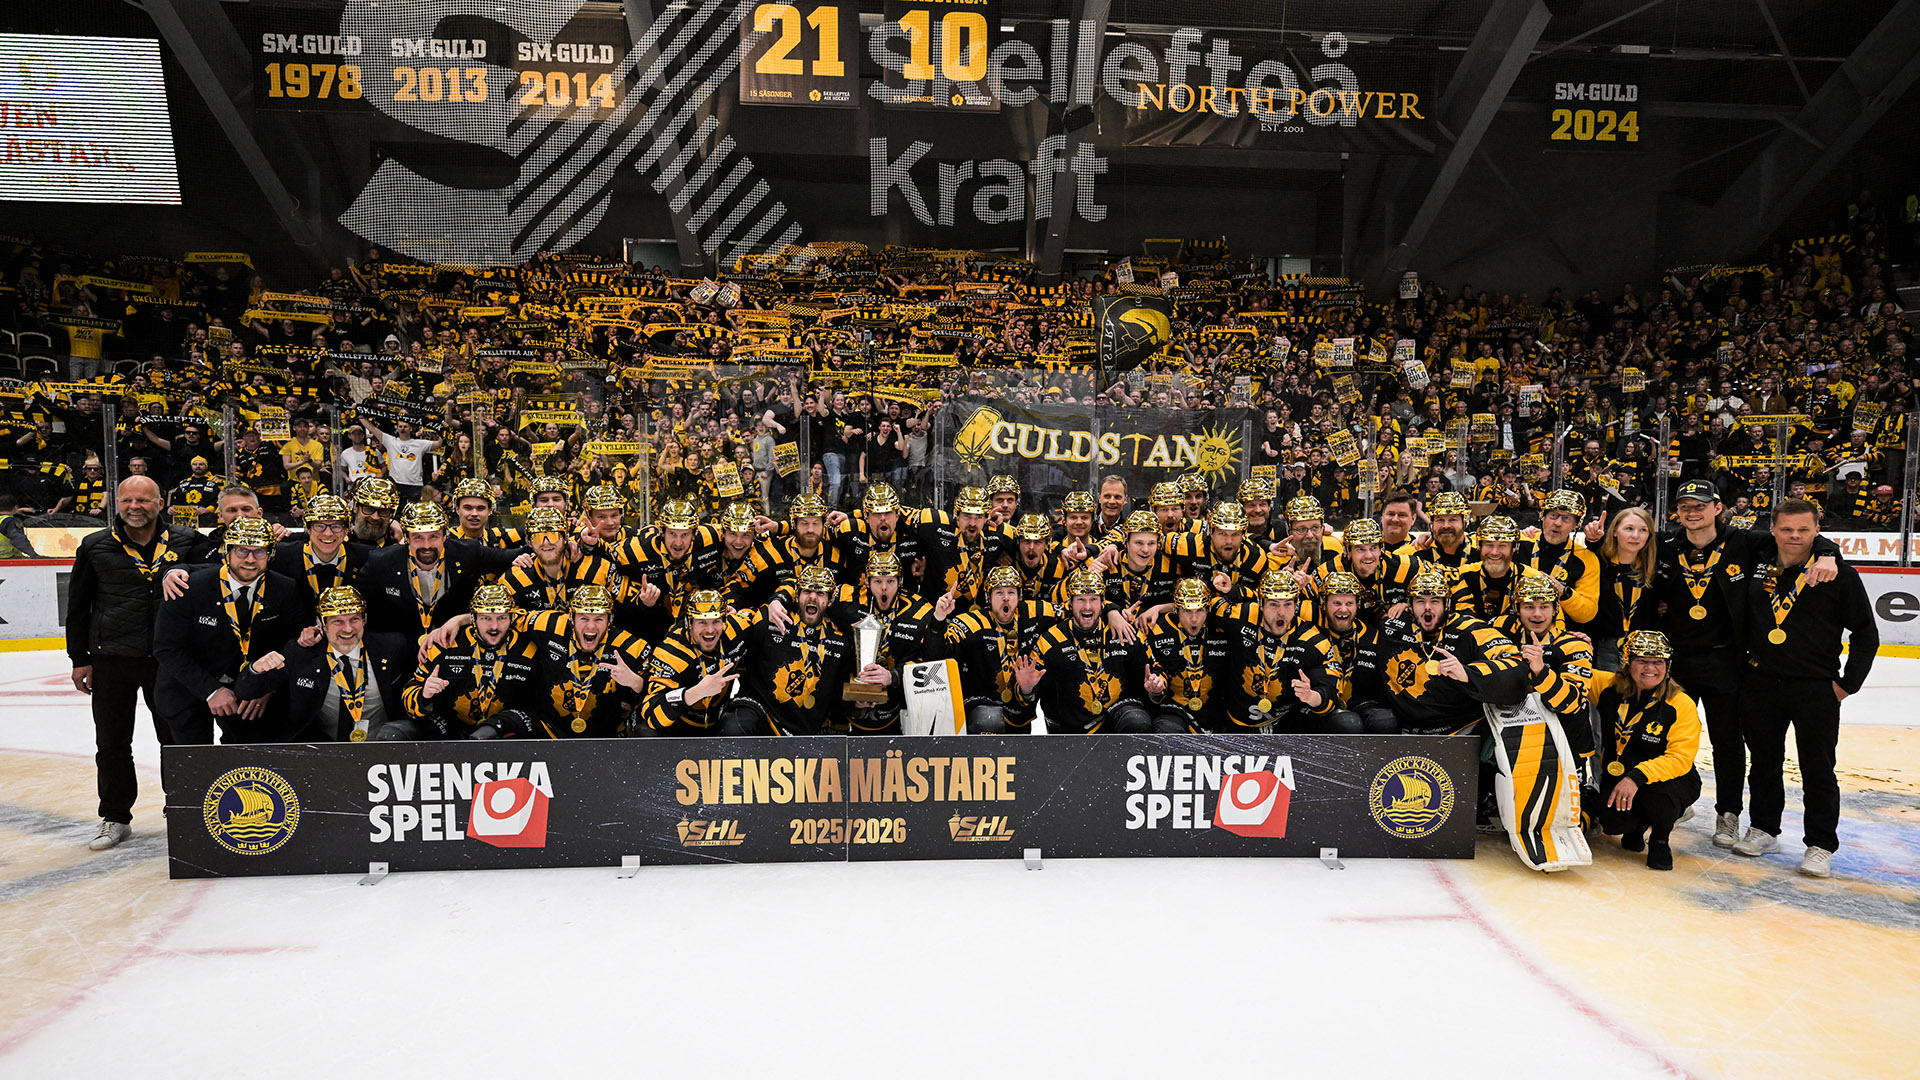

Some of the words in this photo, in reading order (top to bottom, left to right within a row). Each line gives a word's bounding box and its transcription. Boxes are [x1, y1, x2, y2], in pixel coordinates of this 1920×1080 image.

[262, 33, 361, 55] SM-GULD
[391, 39, 487, 59] SM-GULD
[518, 42, 614, 64] SM-GULD
[755, 8, 845, 76] 21
[901, 10, 988, 81] 10
[264, 63, 361, 99] 1978
[393, 68, 487, 102] 2013
[519, 71, 615, 107] 2014
[867, 19, 1359, 127] Skellefteå
[759, 89, 793, 98] SÅSONGER
[1137, 83, 1278, 119] NORTH
[1288, 87, 1425, 120] POWER
[1555, 83, 1638, 102] SM-GULD
[1260, 123, 1282, 133] EST.
[1551, 110, 1639, 142] 2024
[870, 134, 1109, 227] Kraft
[507, 662, 531, 671] engcon
[676, 757, 844, 805] SVENSKA
[849, 749, 1017, 804] MÄSTARE
[207, 790, 226, 836] SVENSKA
[1126, 793, 1213, 830] SPEL
[1372, 775, 1389, 819] SVENSKA
[1568, 774, 1581, 823] CCM
[369, 804, 465, 843] SPEL
[790, 818, 907, 845] 2025/2026
